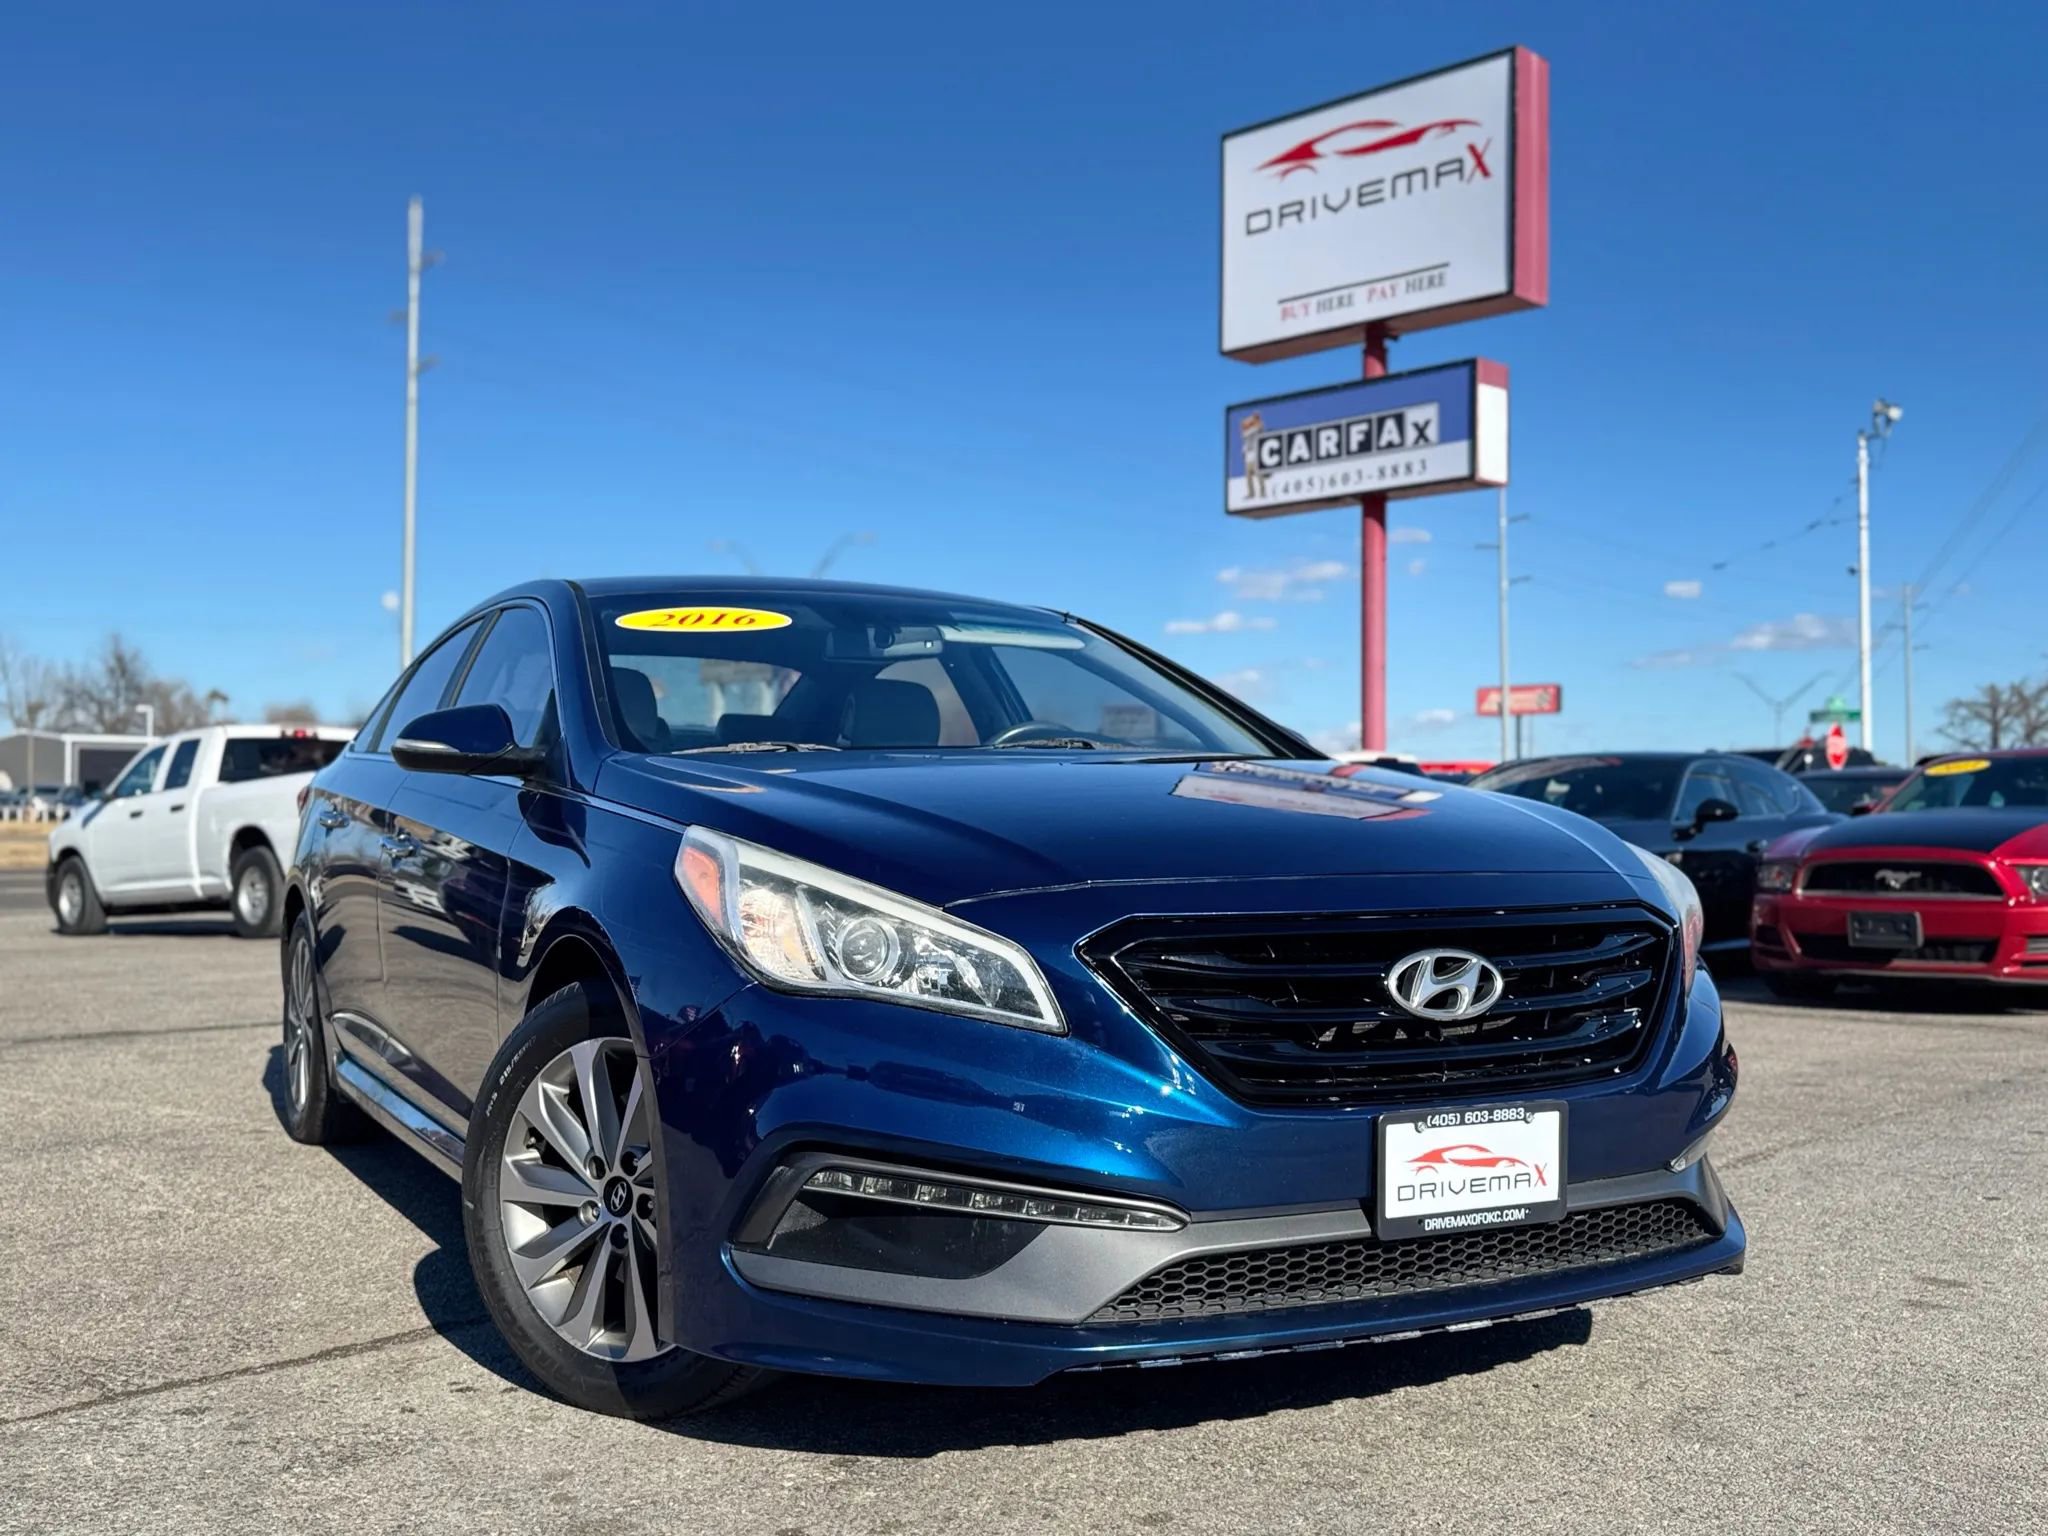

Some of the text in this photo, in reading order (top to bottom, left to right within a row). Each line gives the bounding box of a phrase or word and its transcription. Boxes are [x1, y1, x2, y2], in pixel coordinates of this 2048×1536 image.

[1246, 137, 1493, 236] DRIVEMAX
[1280, 271, 1446, 321] BUY HERE PAY HERE
[1260, 416, 1433, 467] CARFAX
[649, 613, 759, 627] 2016
[1427, 1107, 1526, 1127] (405) 603-8883
[1397, 1163, 1548, 1202] DRIVEMAX
[1424, 1207, 1527, 1232] DRIVEMAXOFOKC.COM
